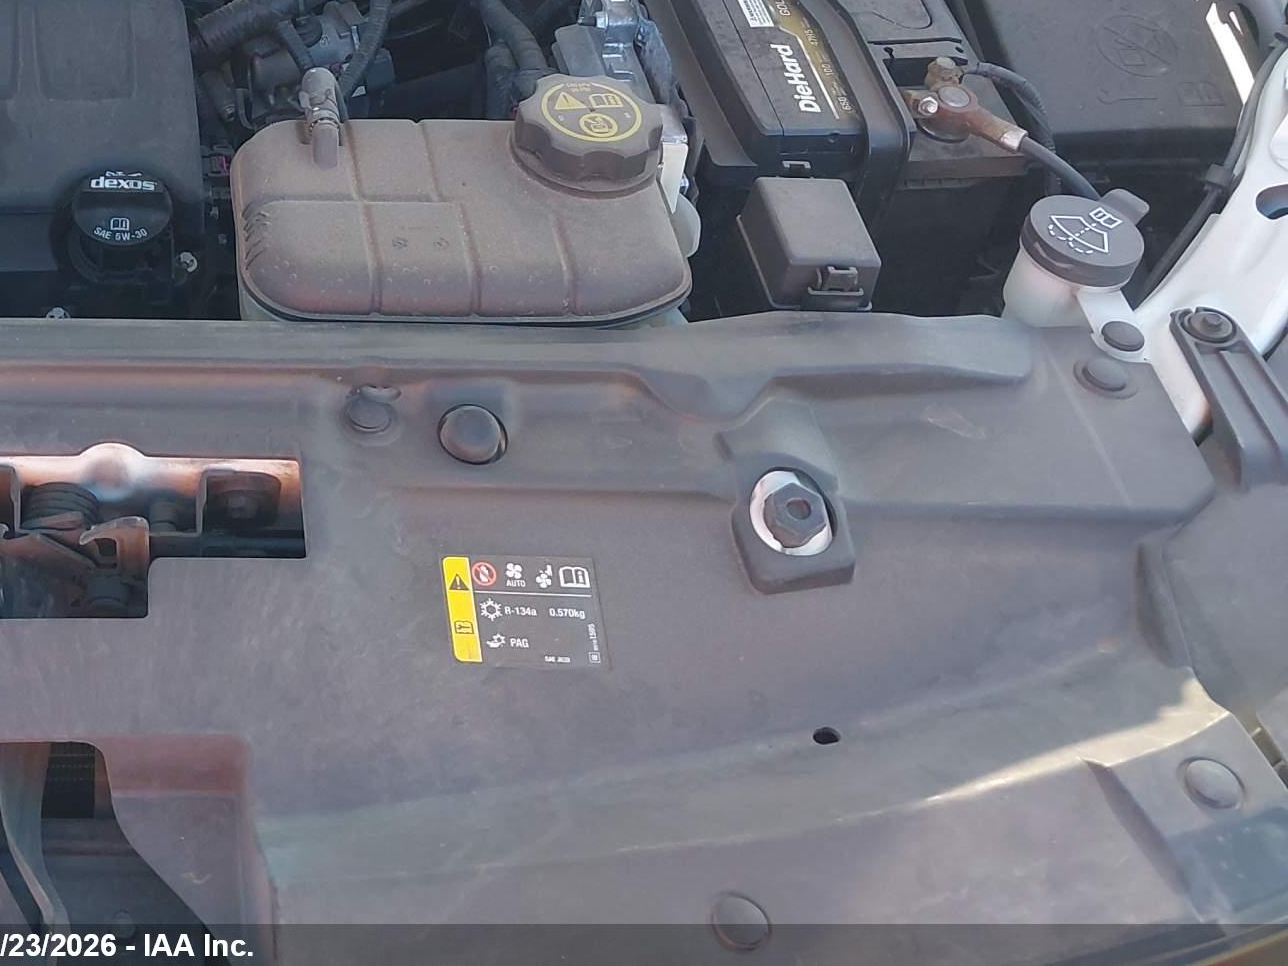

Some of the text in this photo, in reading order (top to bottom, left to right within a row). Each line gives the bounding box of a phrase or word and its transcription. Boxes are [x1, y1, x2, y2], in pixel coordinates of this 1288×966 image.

[769, 43, 822, 113] DieHard
[90, 176, 156, 191] dexos
[93, 226, 148, 241] SAE 5W-30
[506, 579, 526, 588] AUTO
[504, 606, 586, 620] R-134a 0.570kg
[510, 637, 530, 649] PAG
